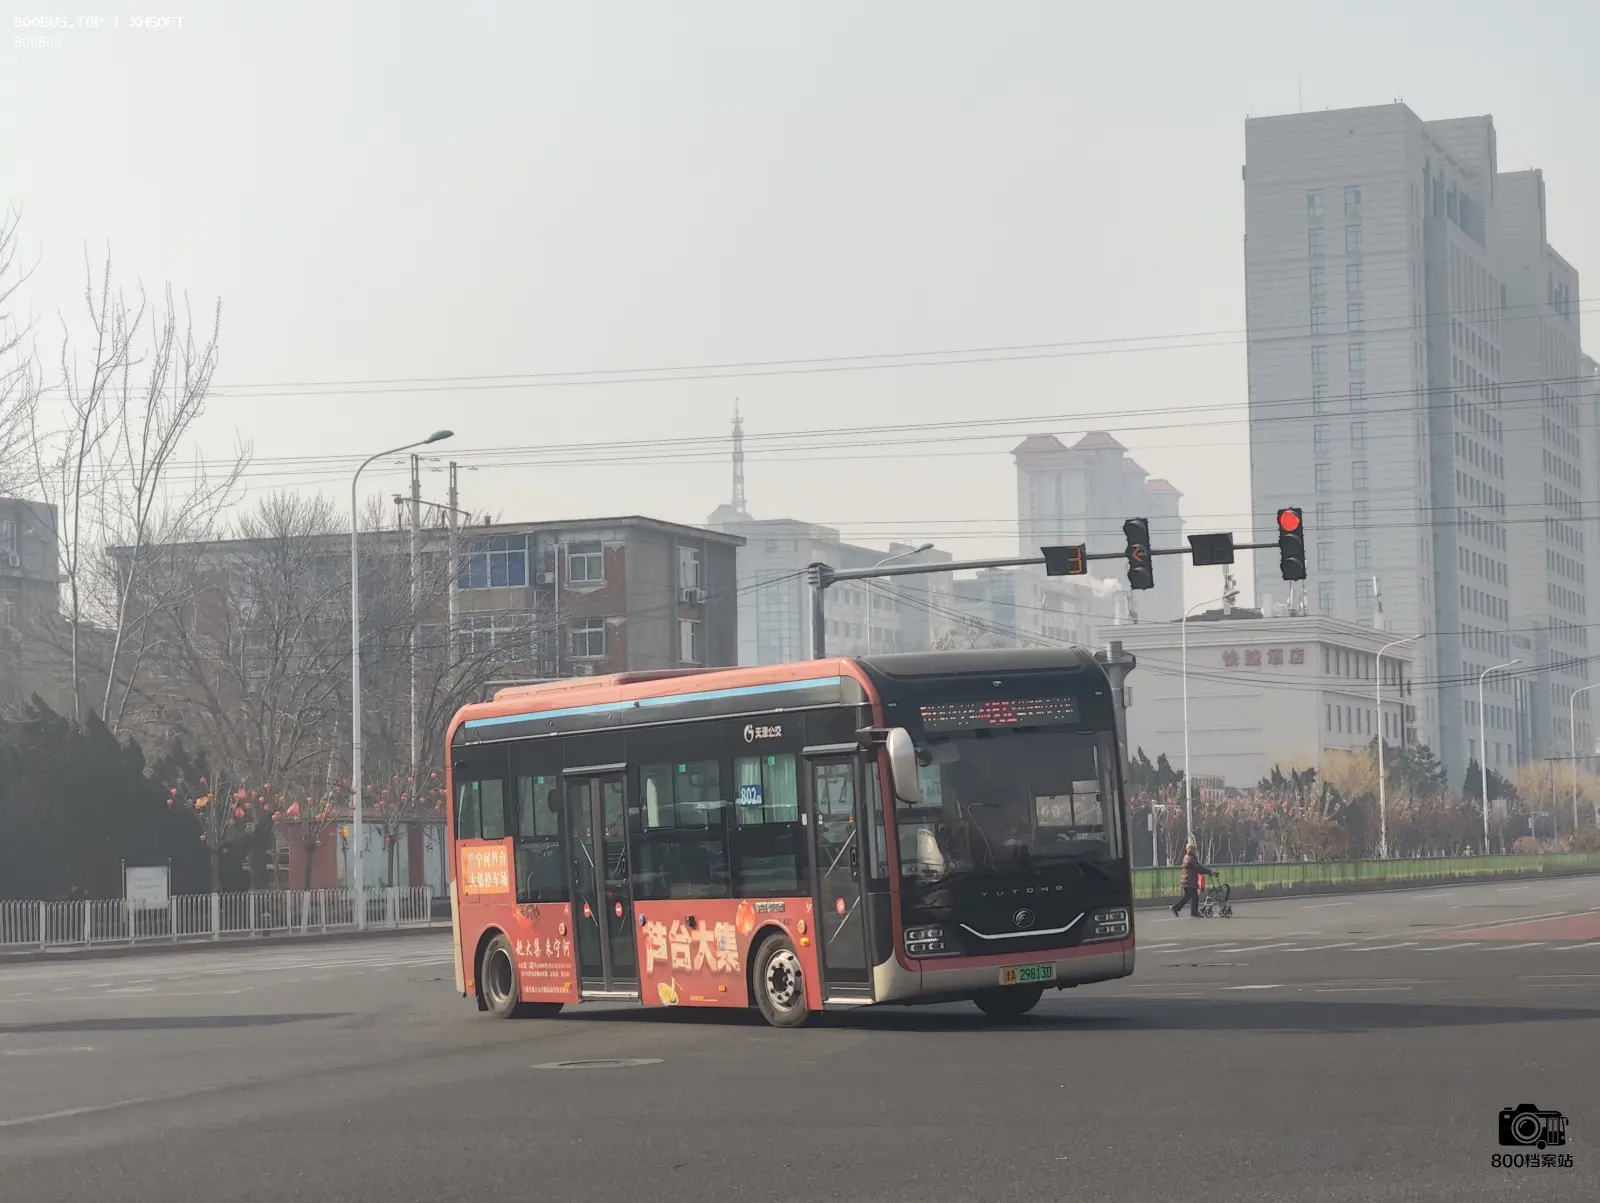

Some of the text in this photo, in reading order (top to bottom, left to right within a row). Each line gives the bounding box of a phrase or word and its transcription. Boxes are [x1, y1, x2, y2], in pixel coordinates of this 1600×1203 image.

[755, 726, 783, 739] 天津公交
[981, 885, 1063, 897] YUTONG
[642, 919, 741, 974] 芦台大集
